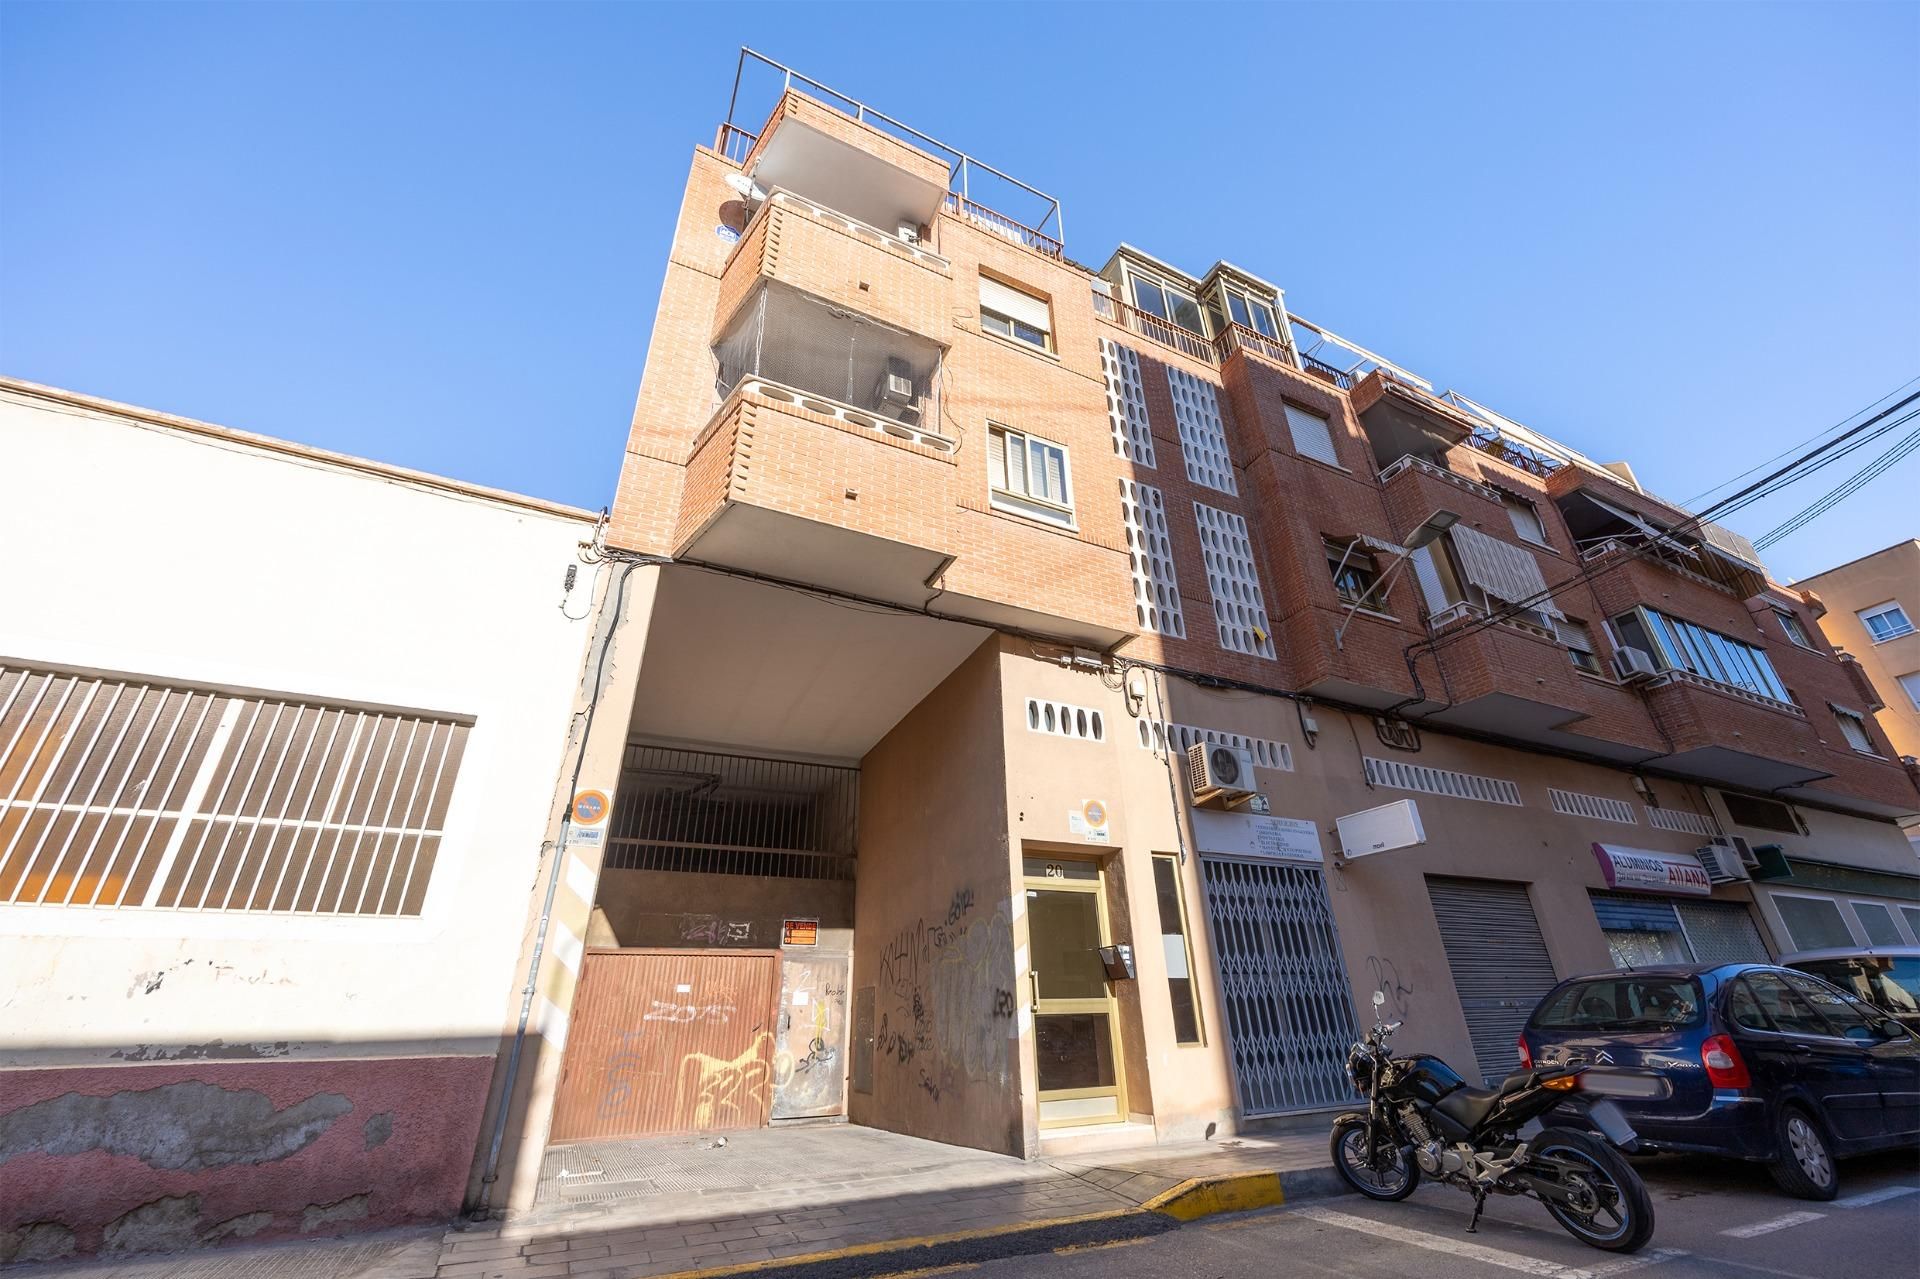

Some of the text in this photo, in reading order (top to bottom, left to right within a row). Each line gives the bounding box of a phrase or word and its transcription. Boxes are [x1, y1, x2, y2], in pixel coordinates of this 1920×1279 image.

[1046, 863, 1063, 877] 20
[1613, 856, 1664, 872] ALUMINIOS
[785, 921, 817, 930] SE VENDE
